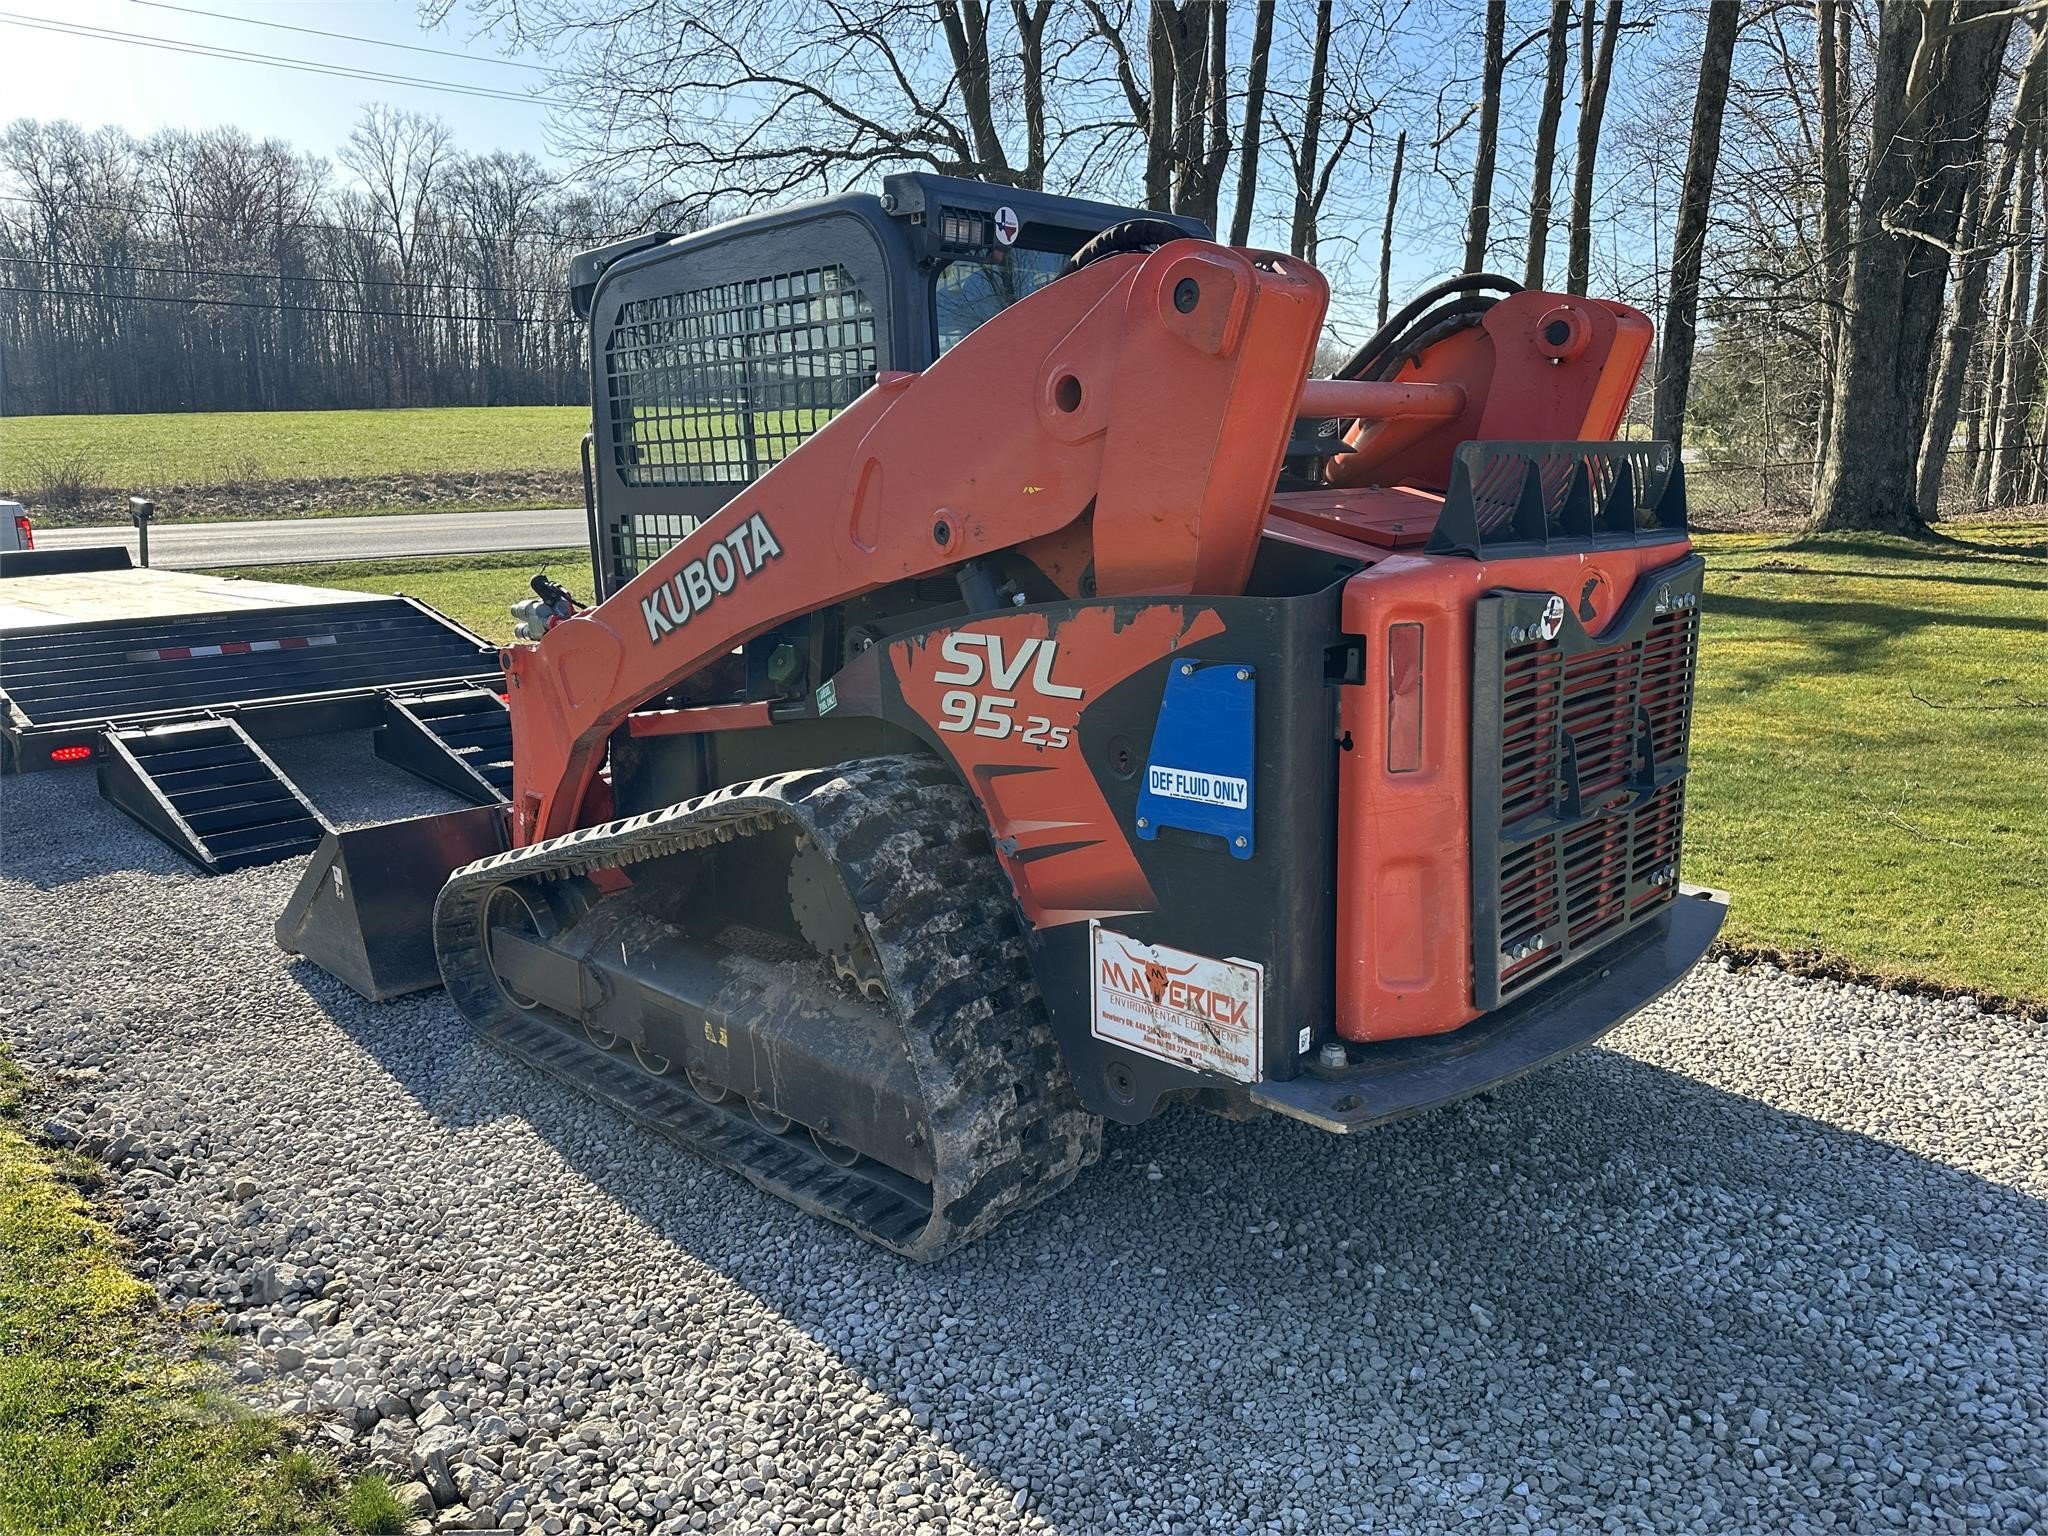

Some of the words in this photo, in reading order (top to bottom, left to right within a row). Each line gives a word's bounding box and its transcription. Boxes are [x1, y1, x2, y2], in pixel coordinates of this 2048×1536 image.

[641, 512, 784, 643] KUBOTA
[934, 632, 1083, 700] SVL
[1151, 770, 1173, 791] DEF
[1176, 774, 1210, 797] FLUID
[1213, 780, 1245, 803] ONLY
[1110, 995, 1182, 1025] ENVIRONMENTAL
